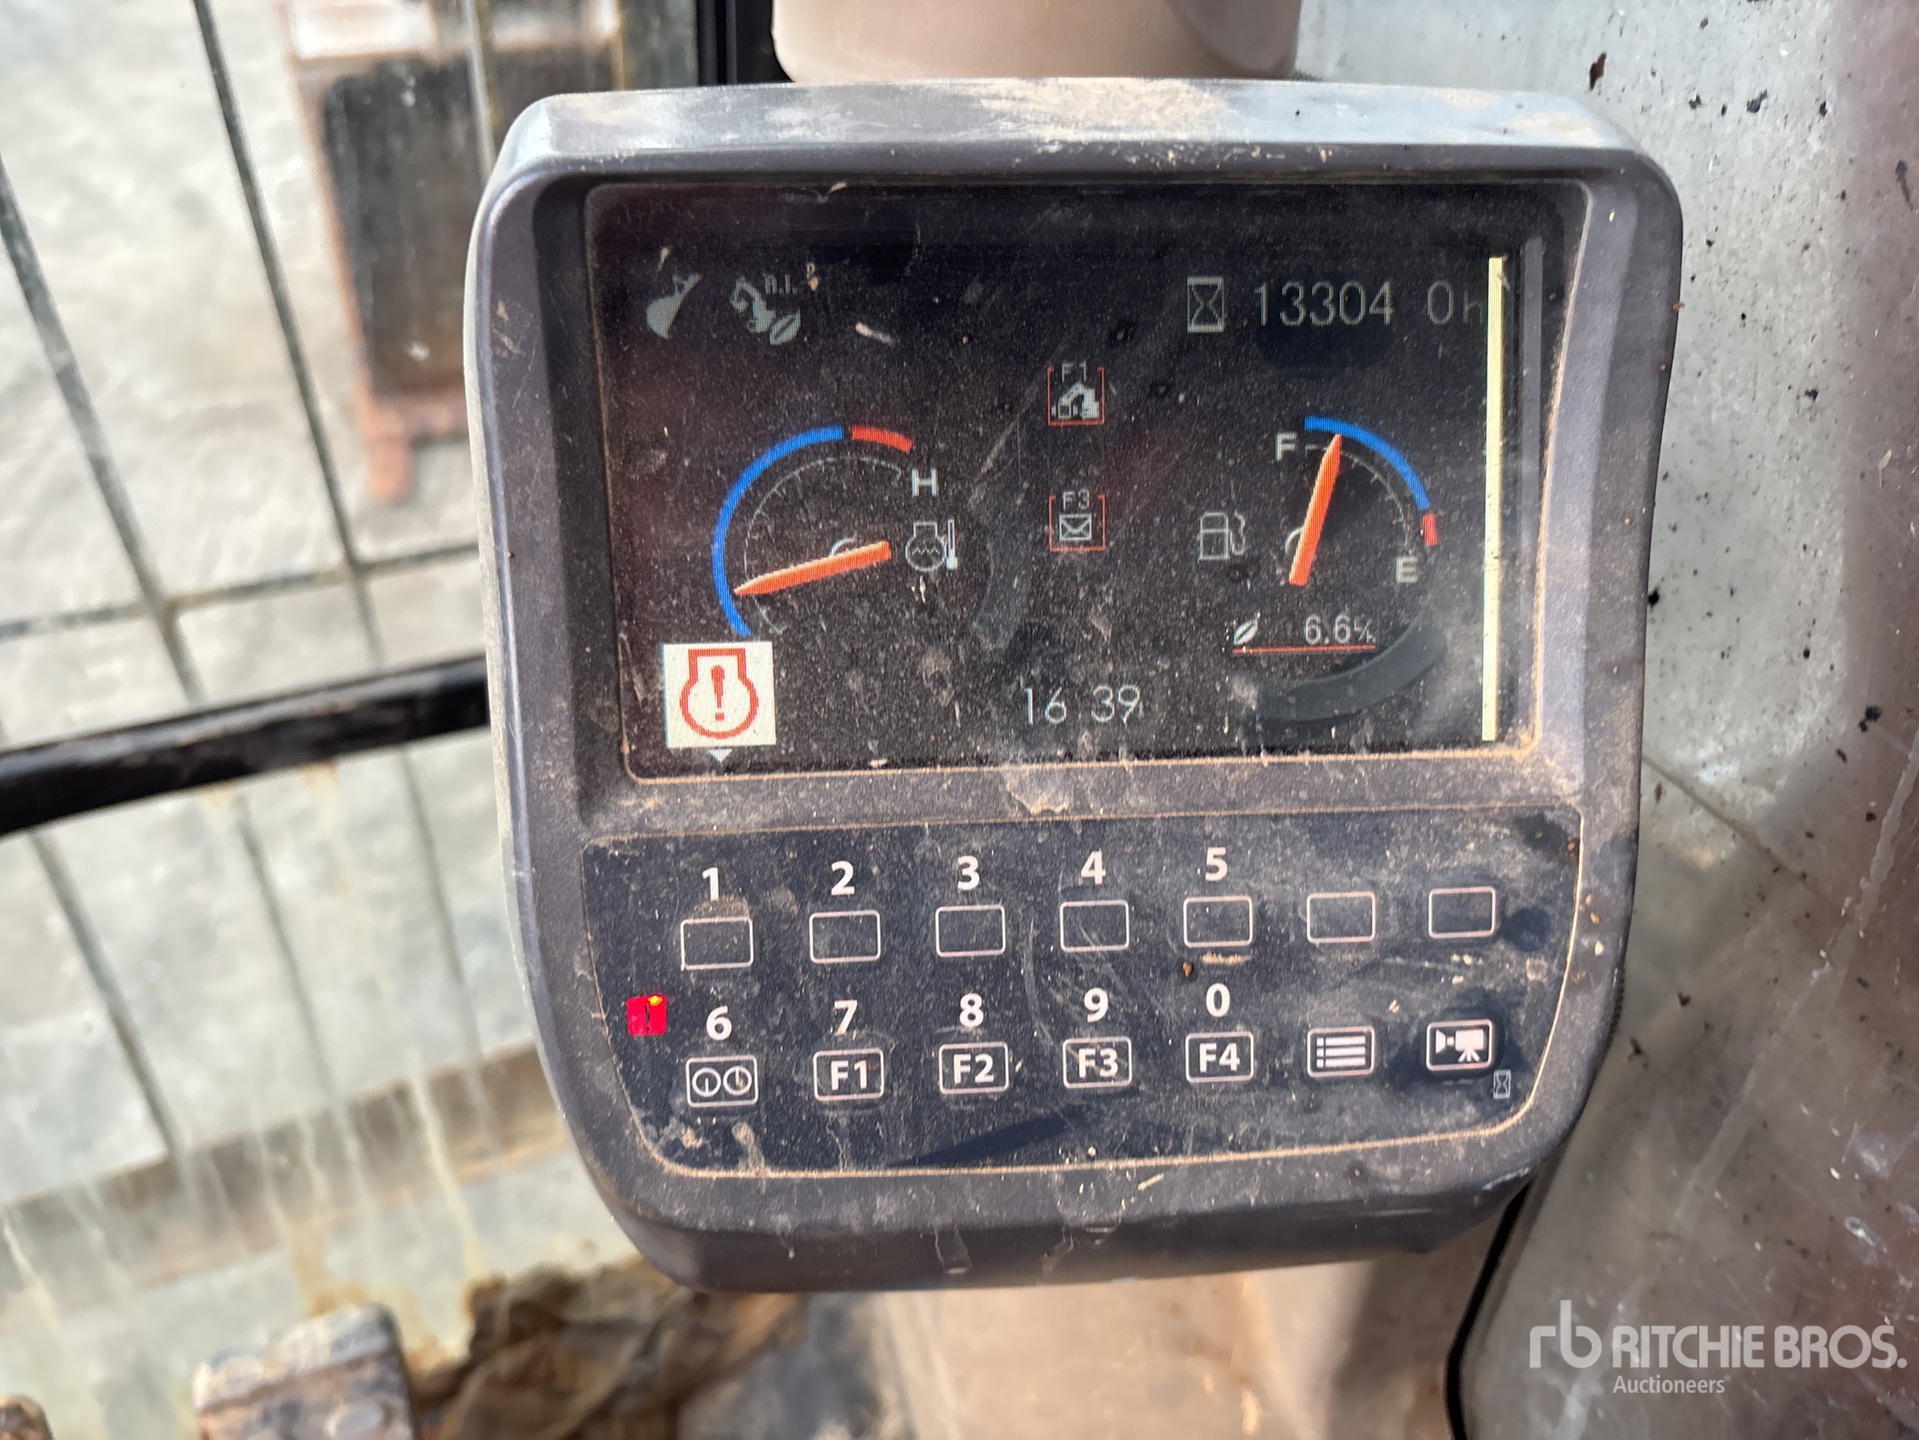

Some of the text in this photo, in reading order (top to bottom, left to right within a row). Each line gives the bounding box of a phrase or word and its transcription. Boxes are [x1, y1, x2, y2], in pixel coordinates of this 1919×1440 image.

[1062, 362, 1087, 382] F1
[1275, 433, 1297, 461] F
[911, 468, 937, 496] H
[1063, 489, 1090, 510] F3
[1396, 558, 1417, 583] E
[831, 861, 855, 895] 2
[957, 856, 980, 890] 3
[1080, 851, 1106, 885] 4
[1205, 847, 1228, 881] 5
[702, 868, 719, 900] 1
[959, 993, 984, 1028] 8
[1083, 988, 1109, 1022] 9
[1205, 983, 1230, 1017] 0
[706, 1006, 732, 1040] 6
[834, 1000, 858, 1034] 7
[953, 1053, 994, 1084] F2
[1078, 1048, 1119, 1079] F3
[1199, 1043, 1240, 1073] F4
[830, 1060, 868, 1090] F1
